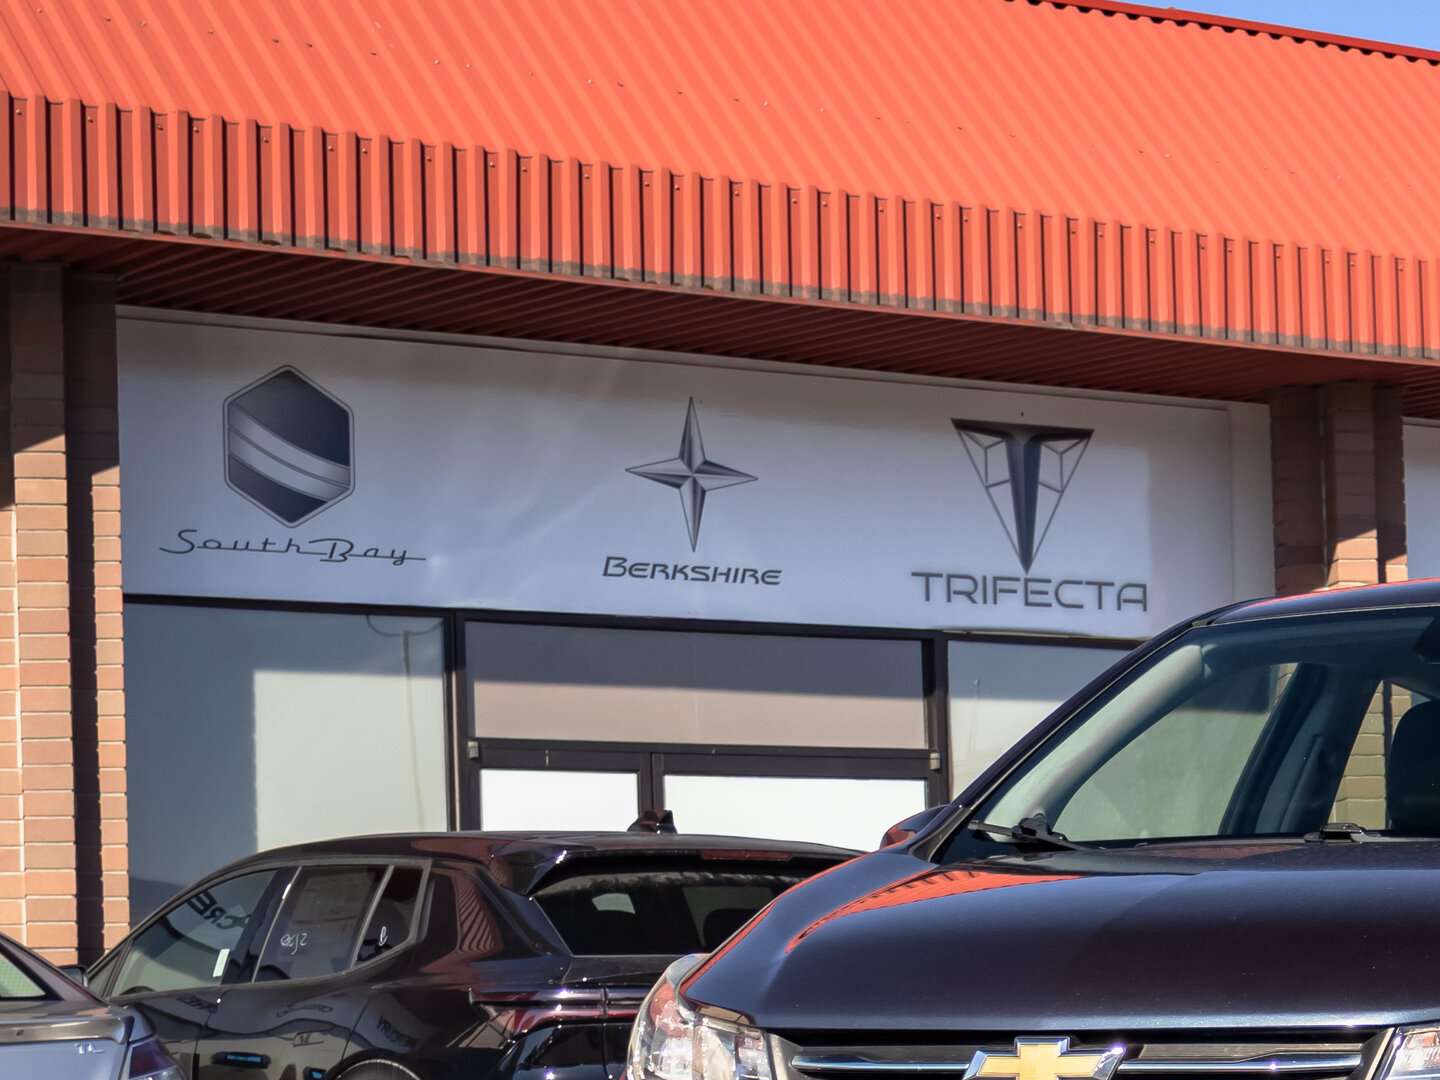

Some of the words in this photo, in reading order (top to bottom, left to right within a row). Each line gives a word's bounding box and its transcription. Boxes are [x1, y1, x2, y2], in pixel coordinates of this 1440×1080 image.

[159, 528, 328, 555] South
[308, 537, 427, 566] Bay
[602, 555, 783, 586] BERKSHIRE
[911, 571, 1148, 612] TRIFECTA
